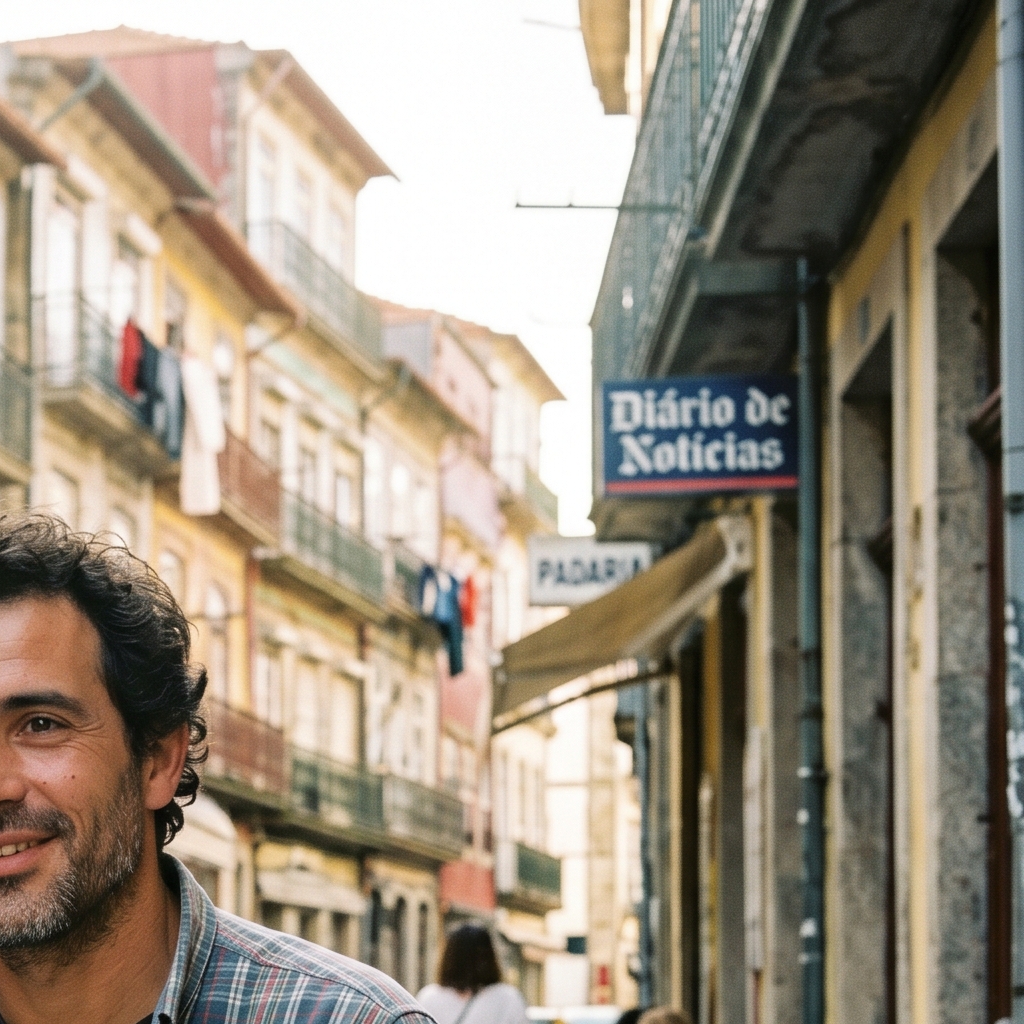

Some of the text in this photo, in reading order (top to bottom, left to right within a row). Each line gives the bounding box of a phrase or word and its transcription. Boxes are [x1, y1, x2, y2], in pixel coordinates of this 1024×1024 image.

[608, 386, 791, 433] Diário de
[617, 431, 785, 476] Notícias
